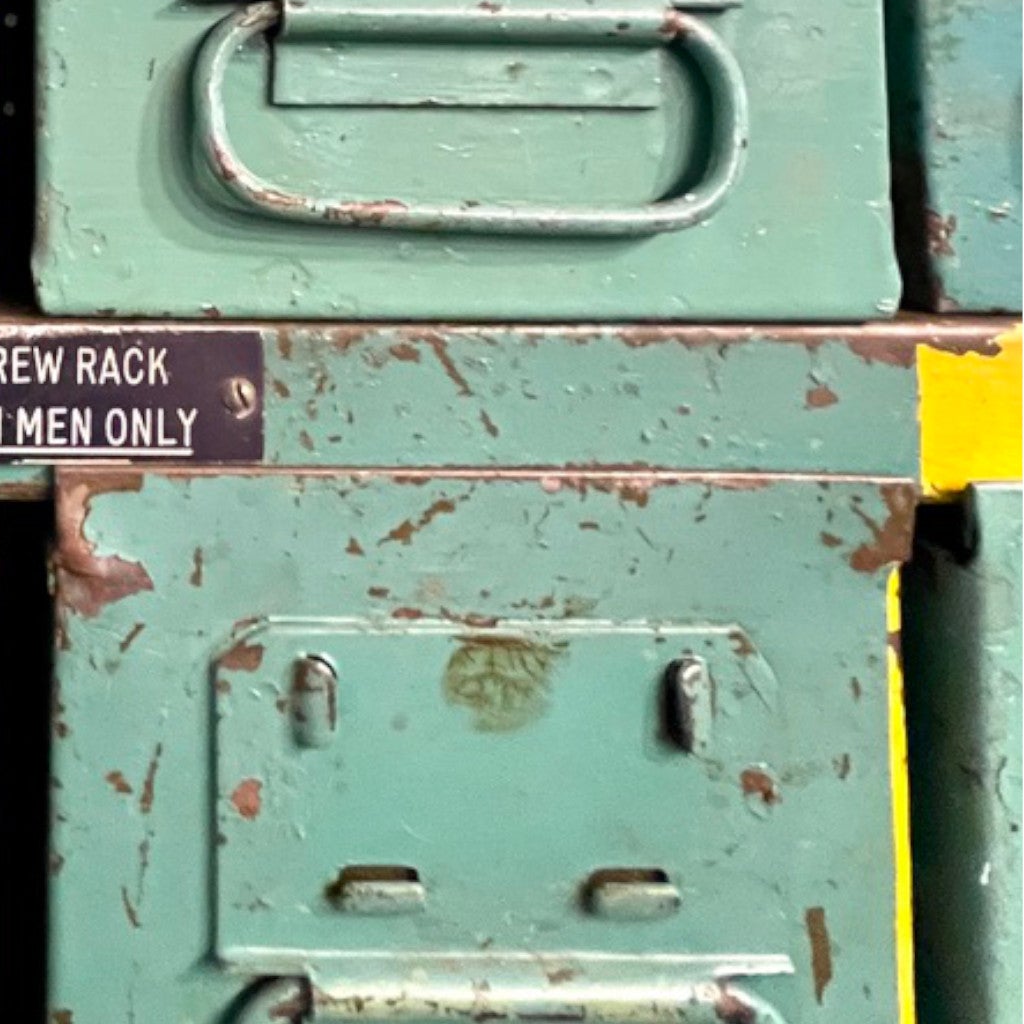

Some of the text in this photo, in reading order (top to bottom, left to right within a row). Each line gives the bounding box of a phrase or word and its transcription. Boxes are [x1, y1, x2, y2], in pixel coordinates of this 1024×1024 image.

[76, 346, 170, 387] RACK
[16, 407, 93, 447] MEN
[104, 407, 199, 447] ONLY
